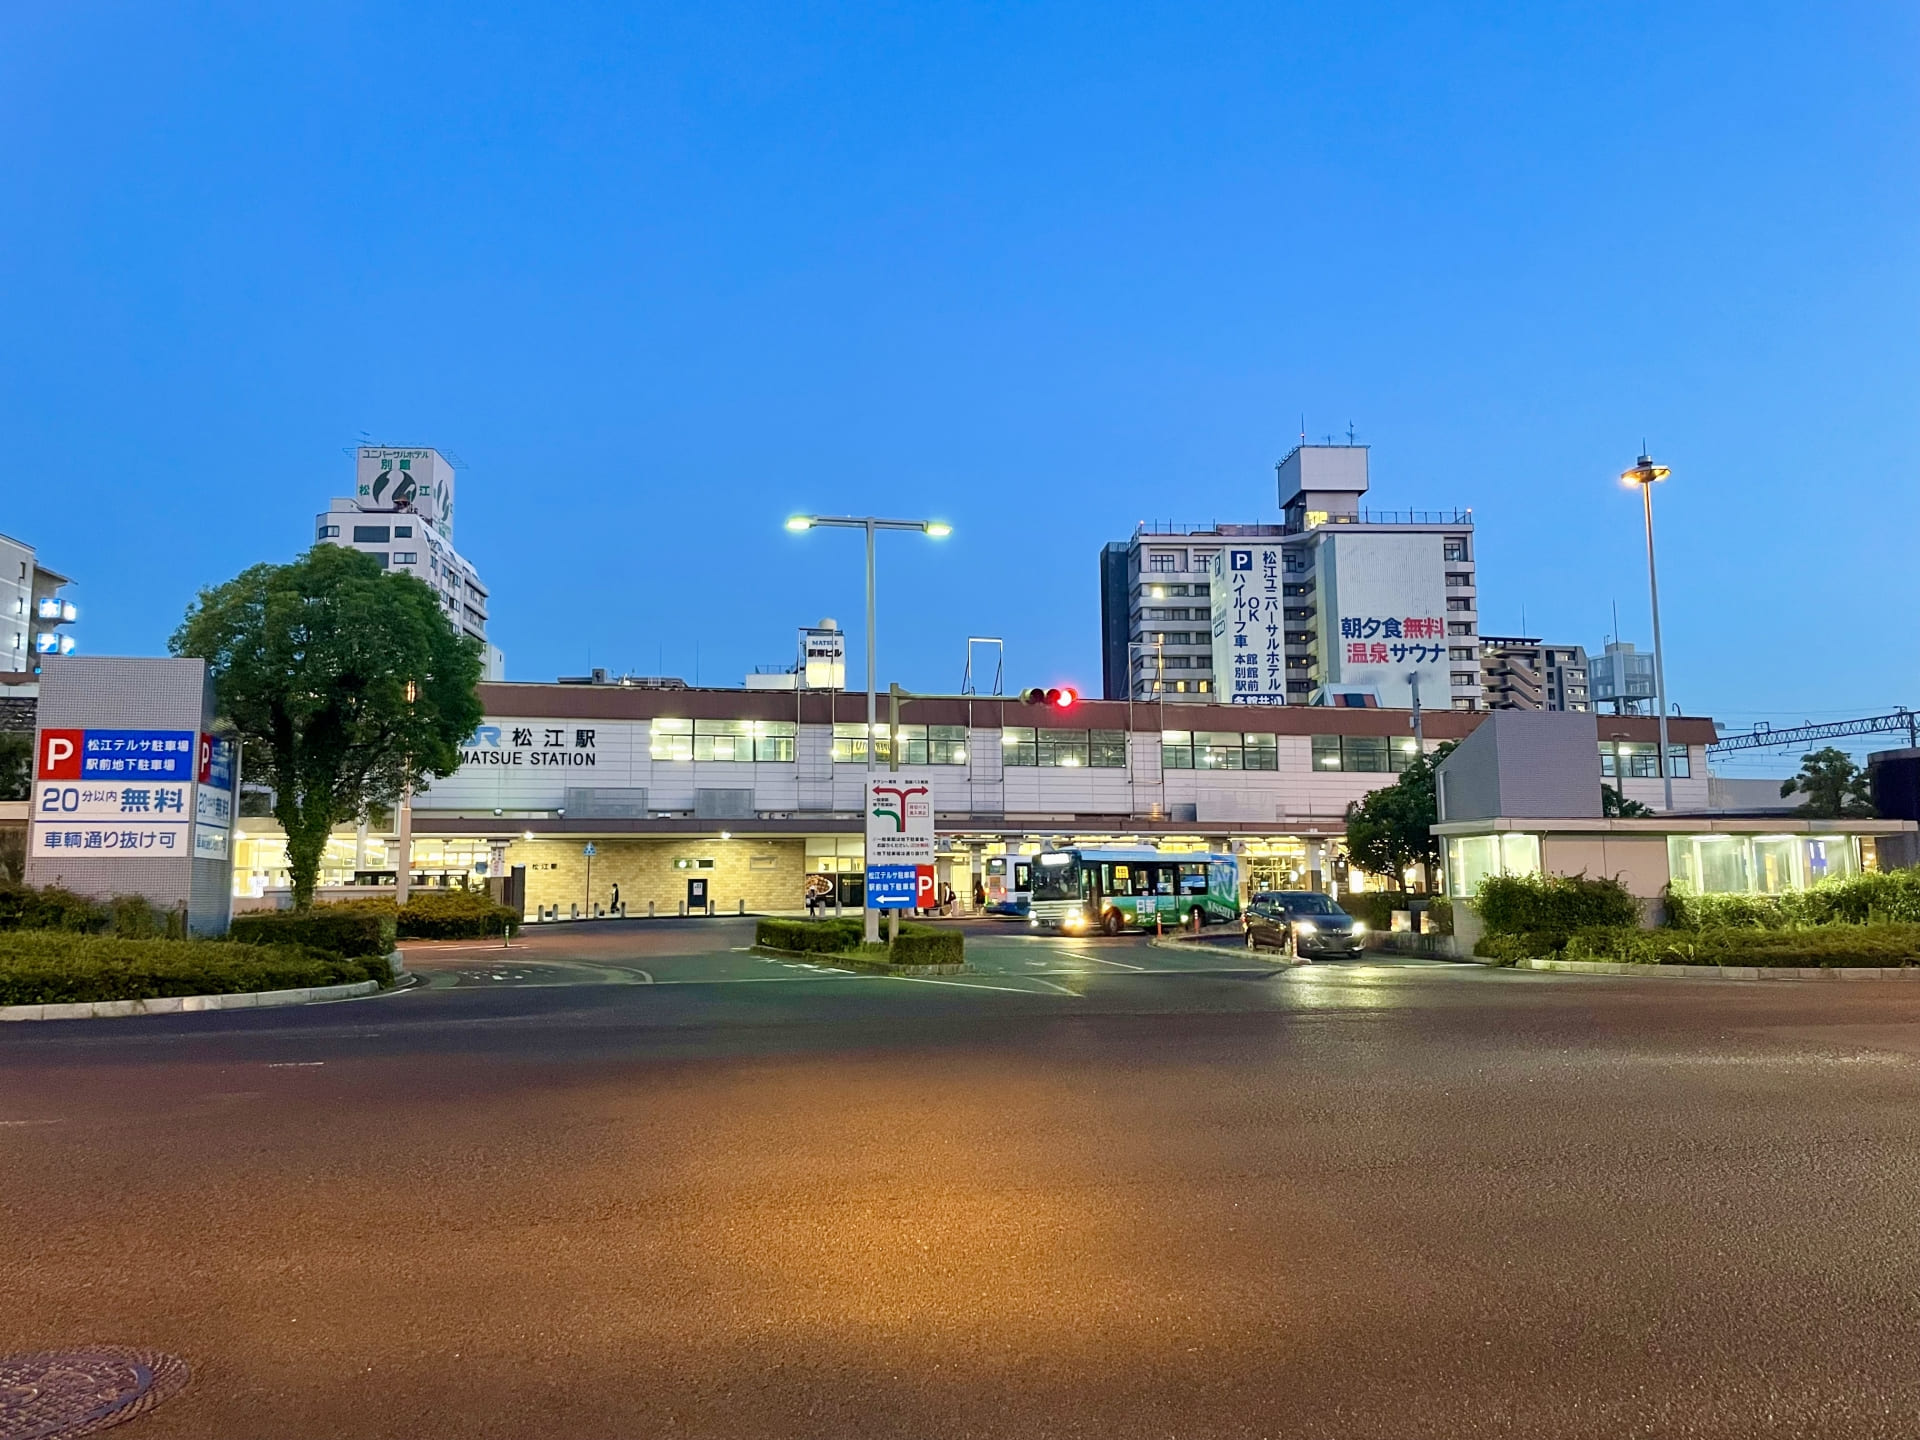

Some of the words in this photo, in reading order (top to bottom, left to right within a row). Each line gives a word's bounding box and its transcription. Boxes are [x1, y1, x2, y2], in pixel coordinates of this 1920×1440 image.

[362, 450, 429, 459] ユニバーサルホテル
[359, 484, 370, 496] 松
[419, 485, 430, 497] 江
[1237, 554, 1248, 569] P
[1232, 573, 1248, 648] ハイルーフ車
[1248, 597, 1260, 622] OK
[1263, 551, 1281, 691] 松江ユニバーサルホテル
[1340, 617, 1445, 639] 朝夕食無料
[1347, 642, 1446, 664] 温泉サウナ
[1234, 667, 1258, 679] 別館
[1235, 680, 1259, 692] 駅前
[87, 739, 189, 753] 松江テルサ駐車場
[512, 728, 596, 748] 松江駅
[47, 738, 74, 770] P
[201, 742, 209, 773] P
[459, 751, 523, 765] MATSUE
[530, 752, 596, 766] STATION
[86, 758, 176, 772] 駅前地下駐車場
[42, 788, 184, 813] 20分以内無料
[918, 875, 933, 897] P
